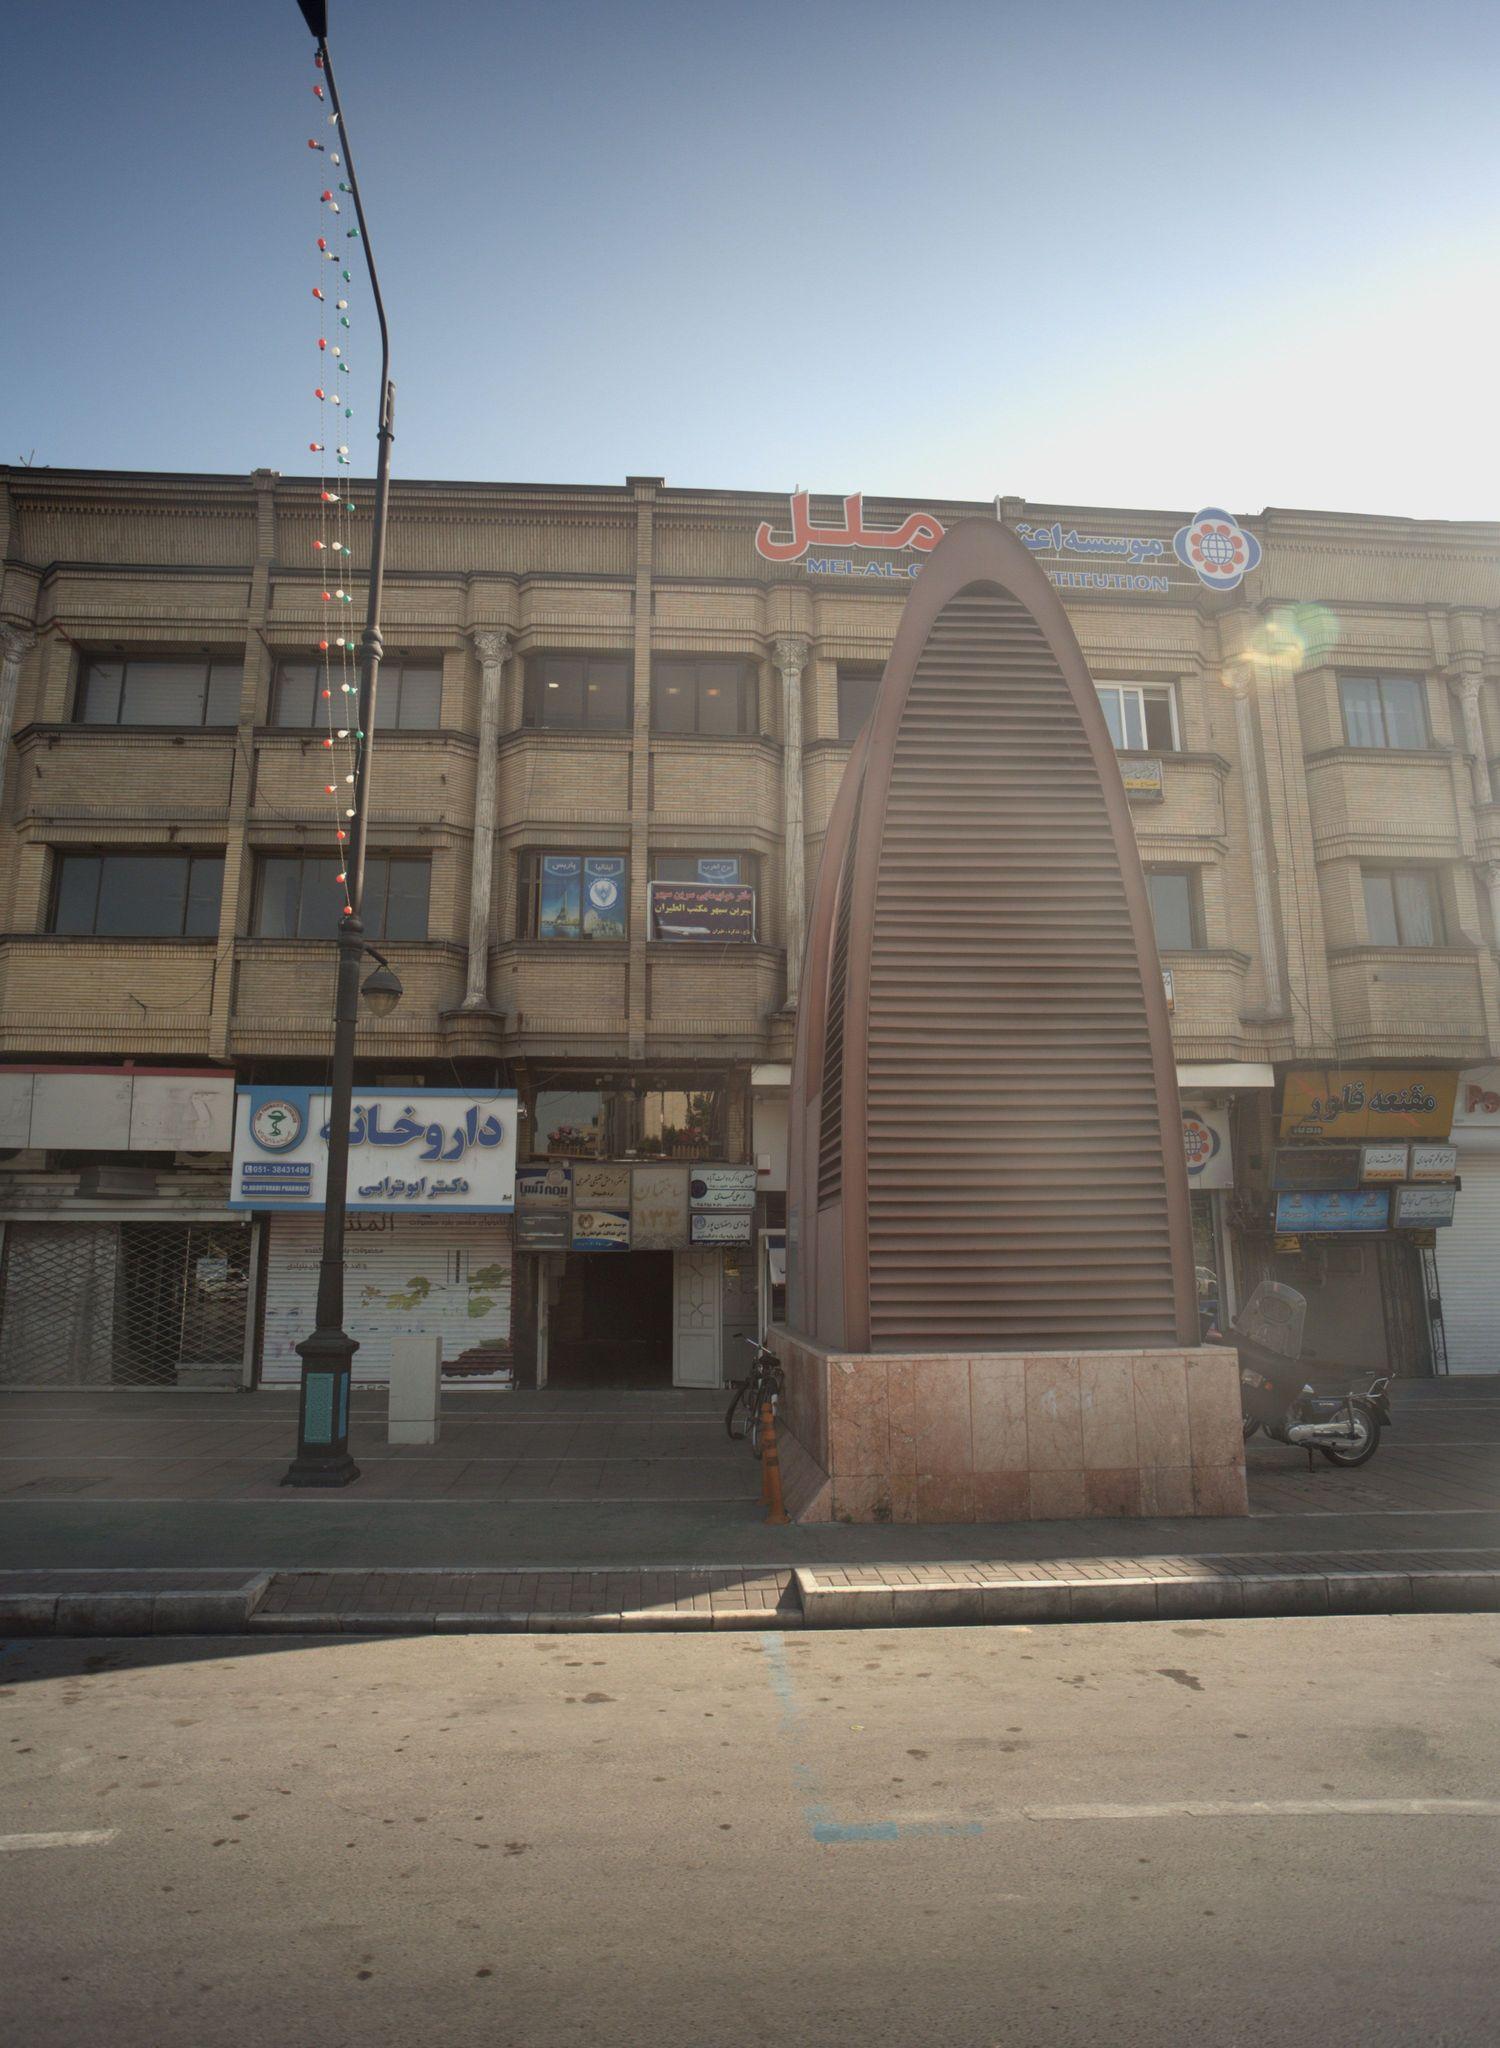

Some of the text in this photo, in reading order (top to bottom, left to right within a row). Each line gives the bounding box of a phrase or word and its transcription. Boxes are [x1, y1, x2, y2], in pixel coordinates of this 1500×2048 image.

[755, 490, 945, 562] ملل
[1063, 530, 1164, 565] موسسه
[806, 558, 902, 578] MELAL
[1050, 571, 1169, 592] TITUTION
[1369, 1083, 1438, 1115] مقنعه
[429, 1177, 469, 1199] دکتر
